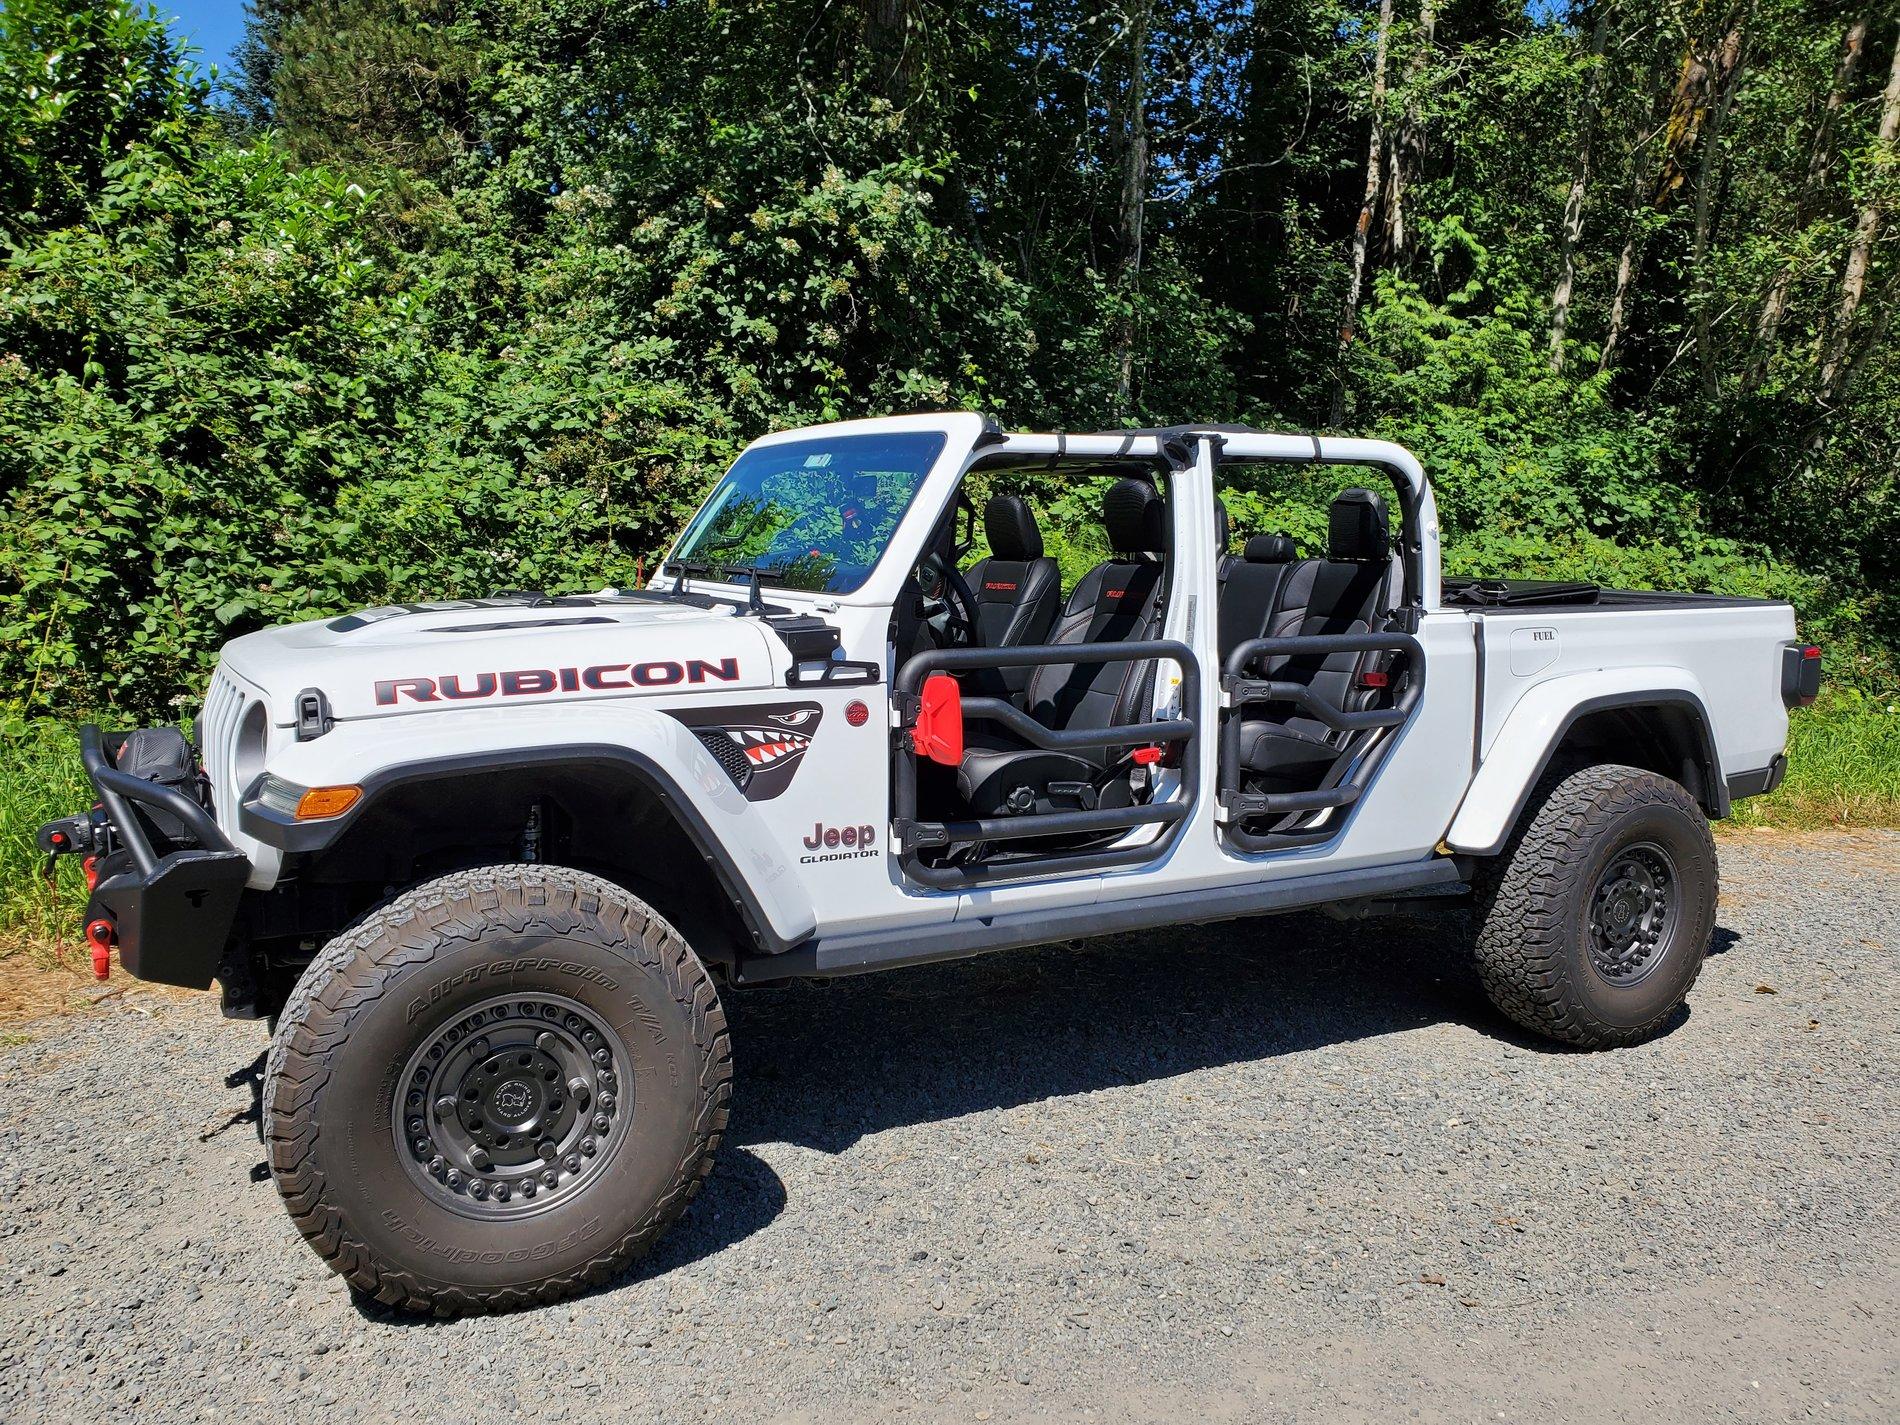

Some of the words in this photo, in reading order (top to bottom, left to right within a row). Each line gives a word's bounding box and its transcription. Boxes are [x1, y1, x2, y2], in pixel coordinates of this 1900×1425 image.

[1533, 631, 1555, 641] FUEL
[374, 658, 740, 706] RUBICON
[803, 822, 876, 851] Jeep
[800, 850, 879, 864] GLADIATOR
[406, 957, 620, 1024] All-Terrain
